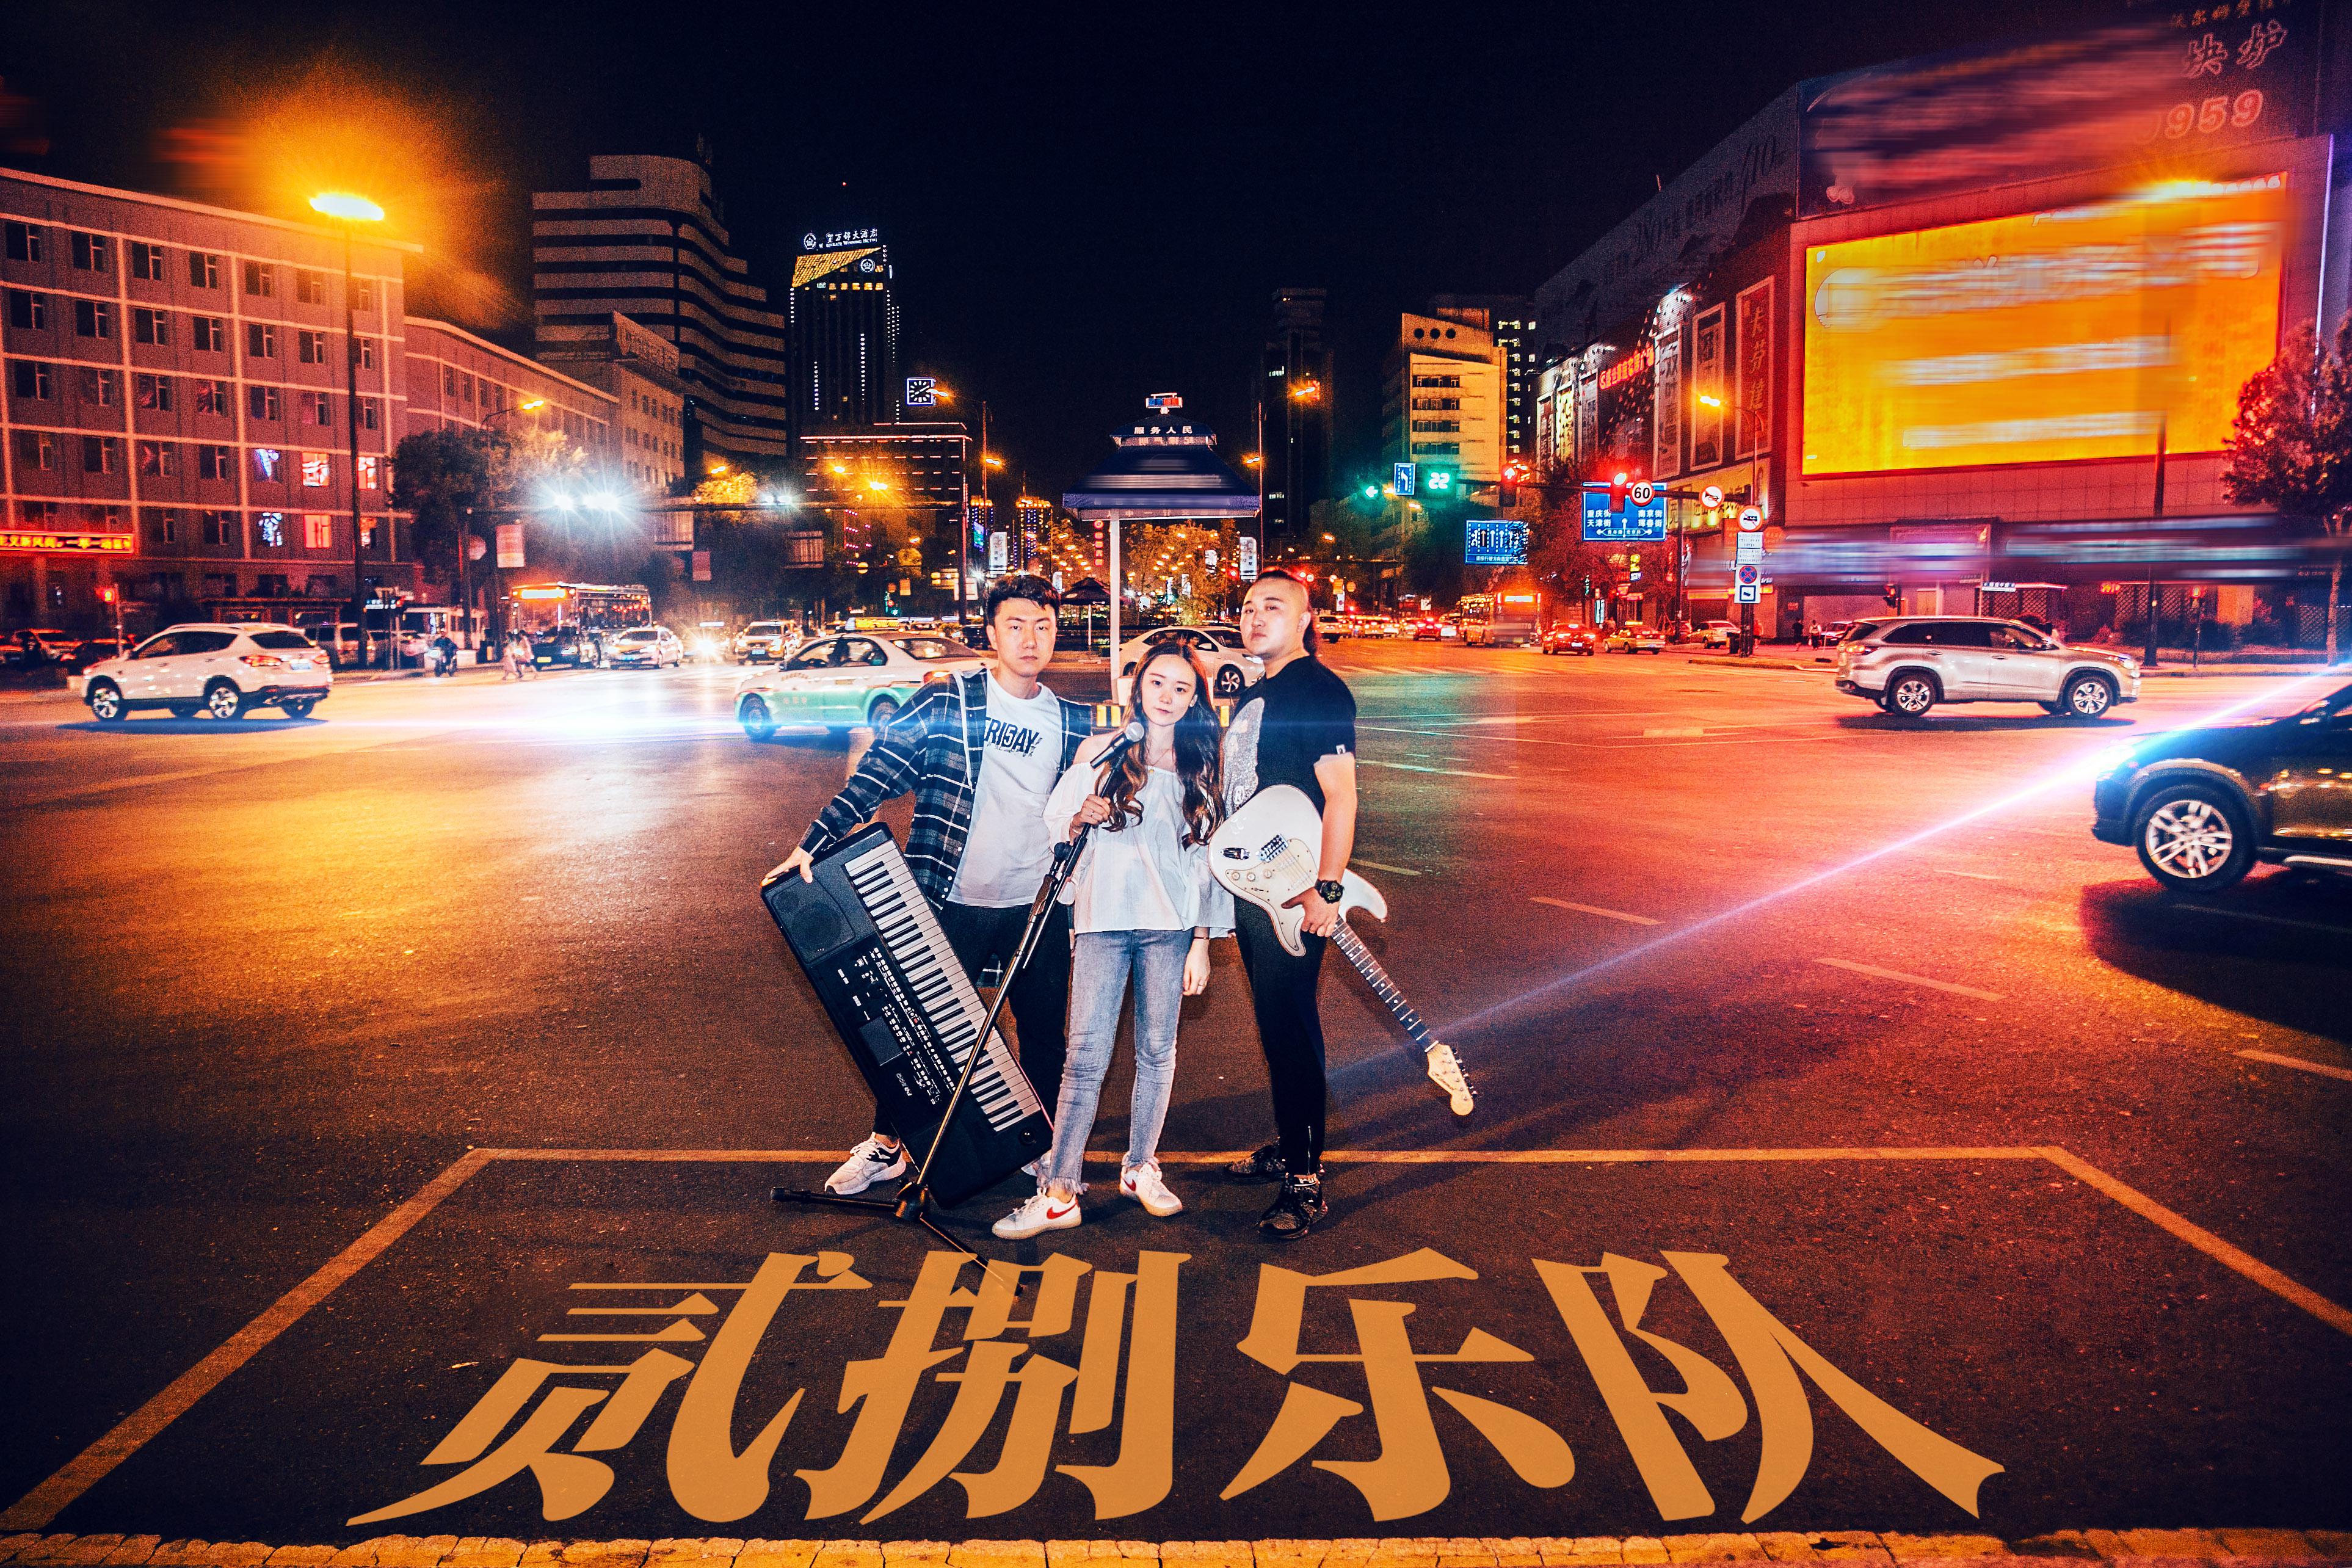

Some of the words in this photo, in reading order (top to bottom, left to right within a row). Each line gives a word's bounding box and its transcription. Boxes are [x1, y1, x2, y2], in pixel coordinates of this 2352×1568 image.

[1134, 426, 1192, 435] 服务人民
[1428, 472, 1450, 489] 22
[1635, 487, 1650, 499] 60
[1638, 509, 1662, 518] 南京街
[1587, 519, 1611, 528] 天津街
[346, 1247, 2006, 1525] 贰捌乐队
